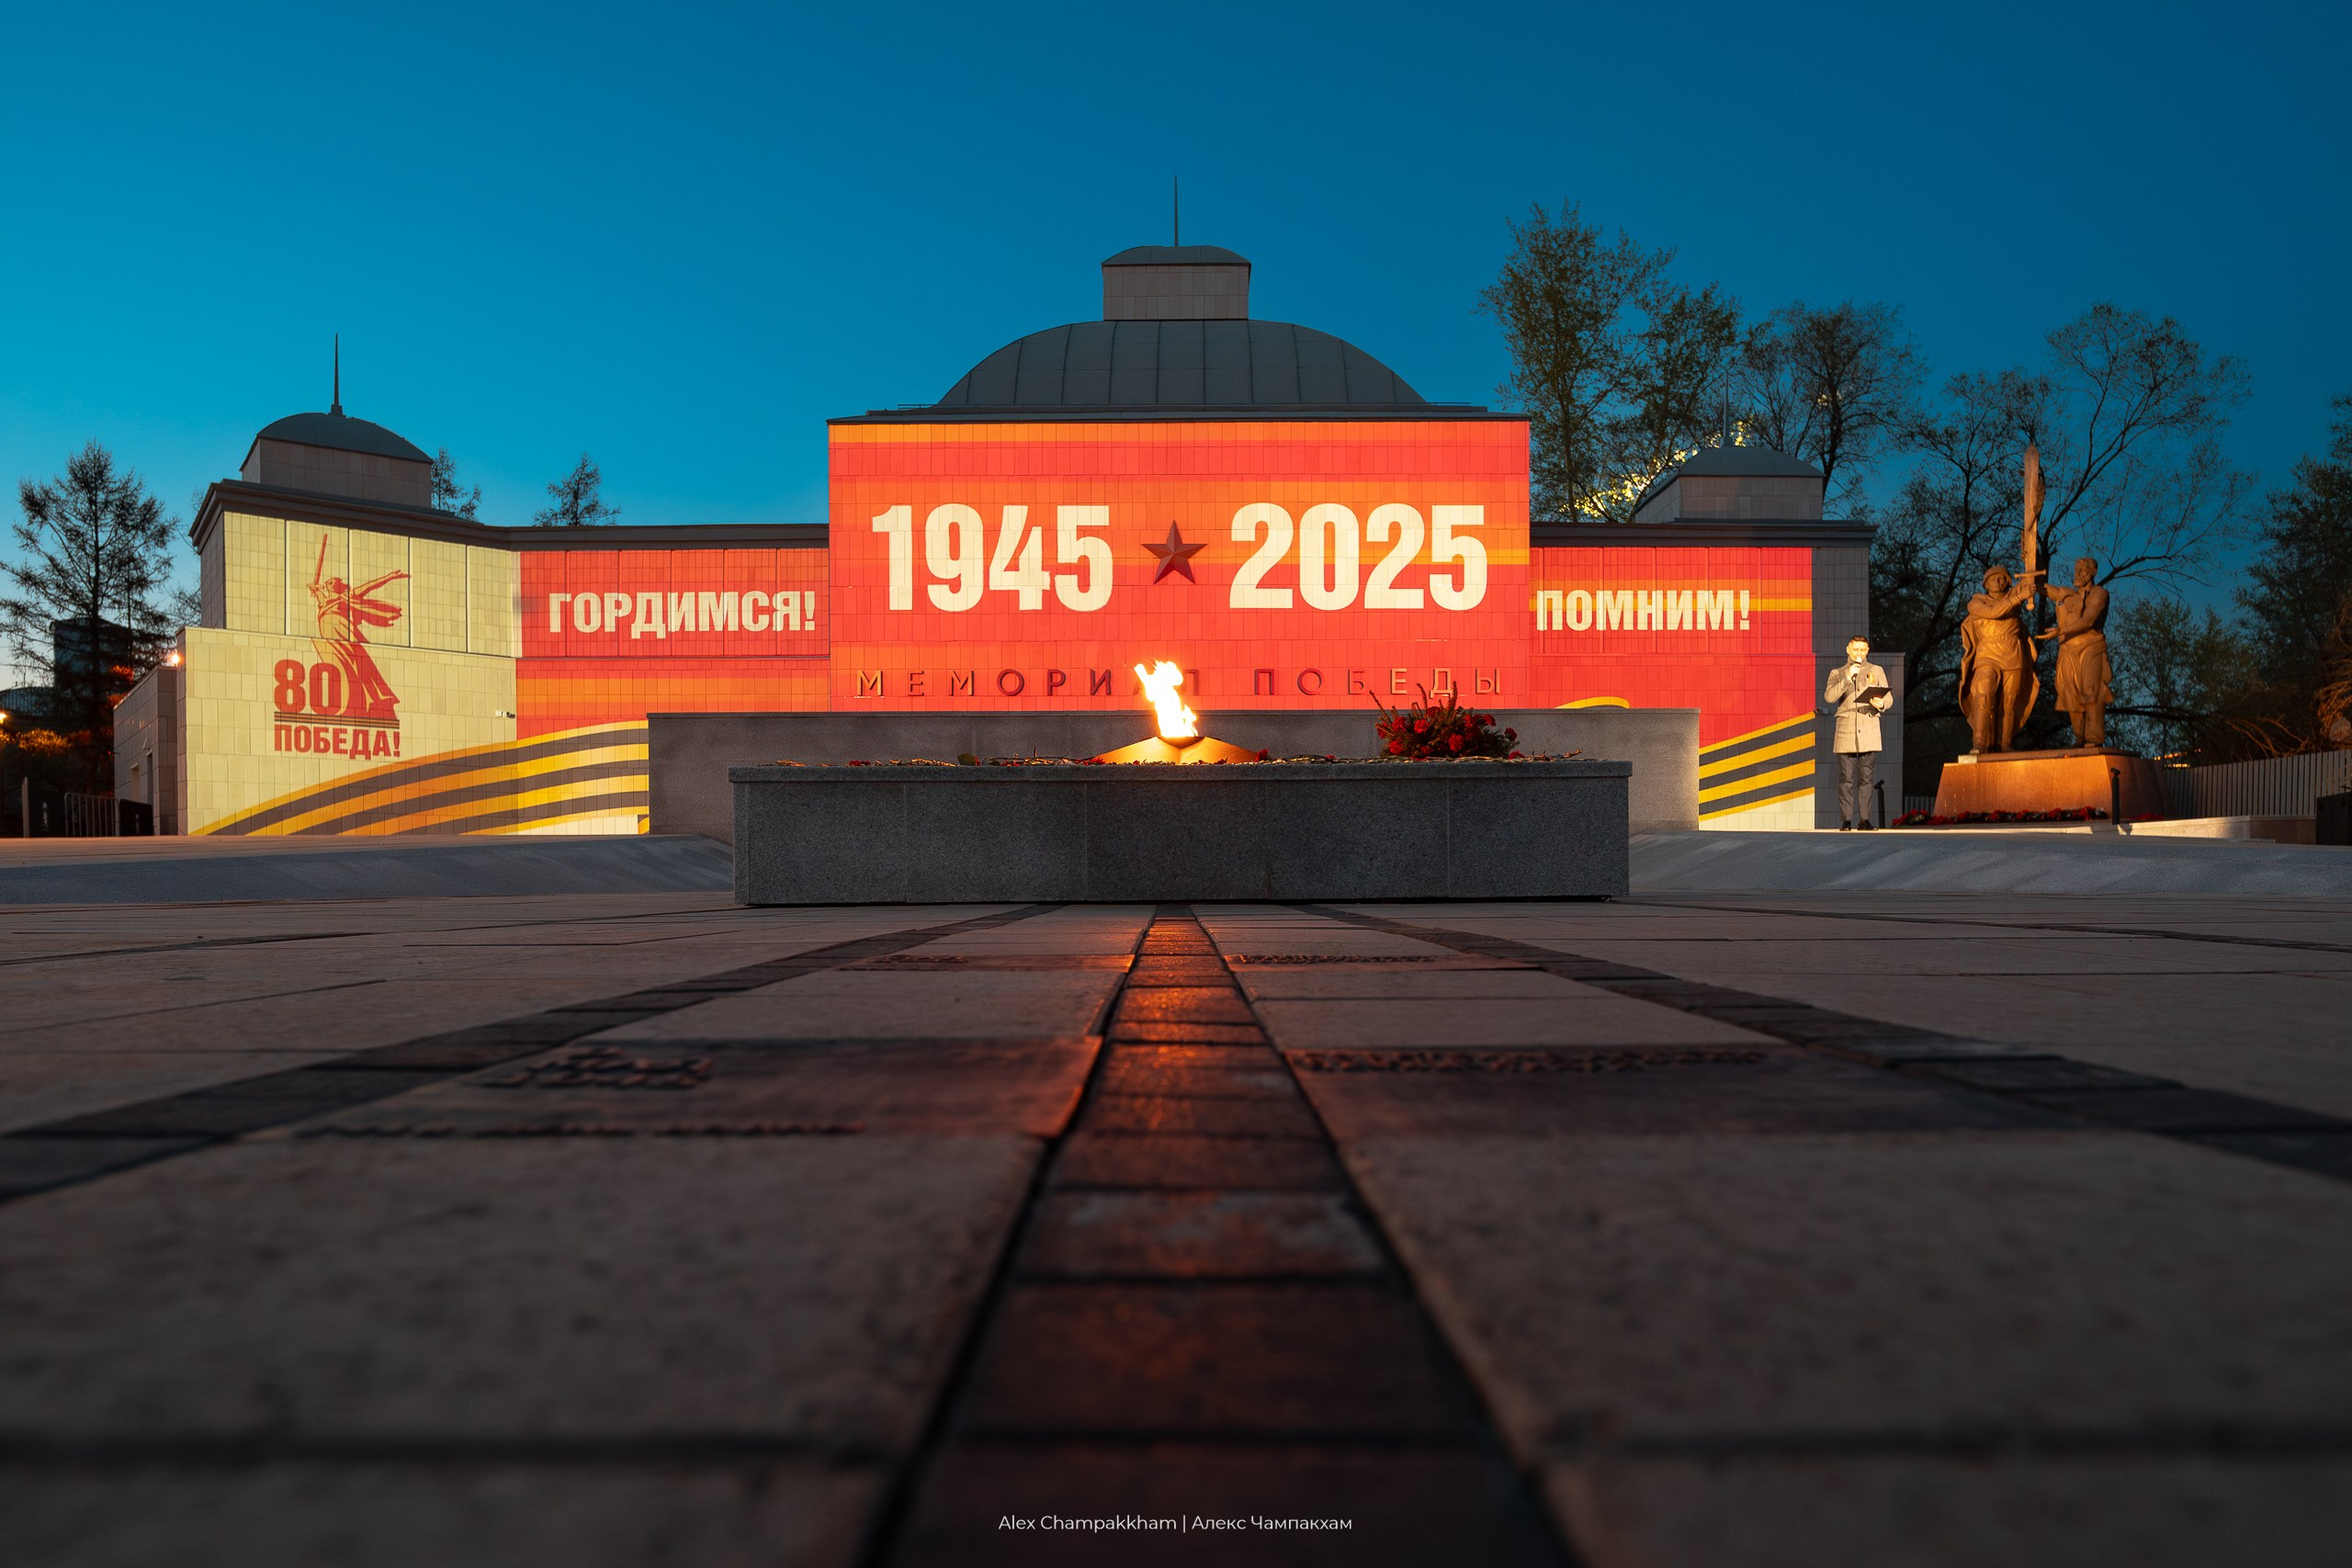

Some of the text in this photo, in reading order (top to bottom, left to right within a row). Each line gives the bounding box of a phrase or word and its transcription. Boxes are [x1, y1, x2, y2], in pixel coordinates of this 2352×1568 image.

[872, 502, 1487, 612] 1945 2025
[548, 591, 816, 638] ГОРДИМСЯ!
[1537, 589, 1750, 631] ПОМНИМ!
[274, 660, 342, 716] 80
[855, 668, 1500, 698] МЕМОРИЛ ПОБЕДЫ
[274, 725, 401, 761] ПОБЕДА!
